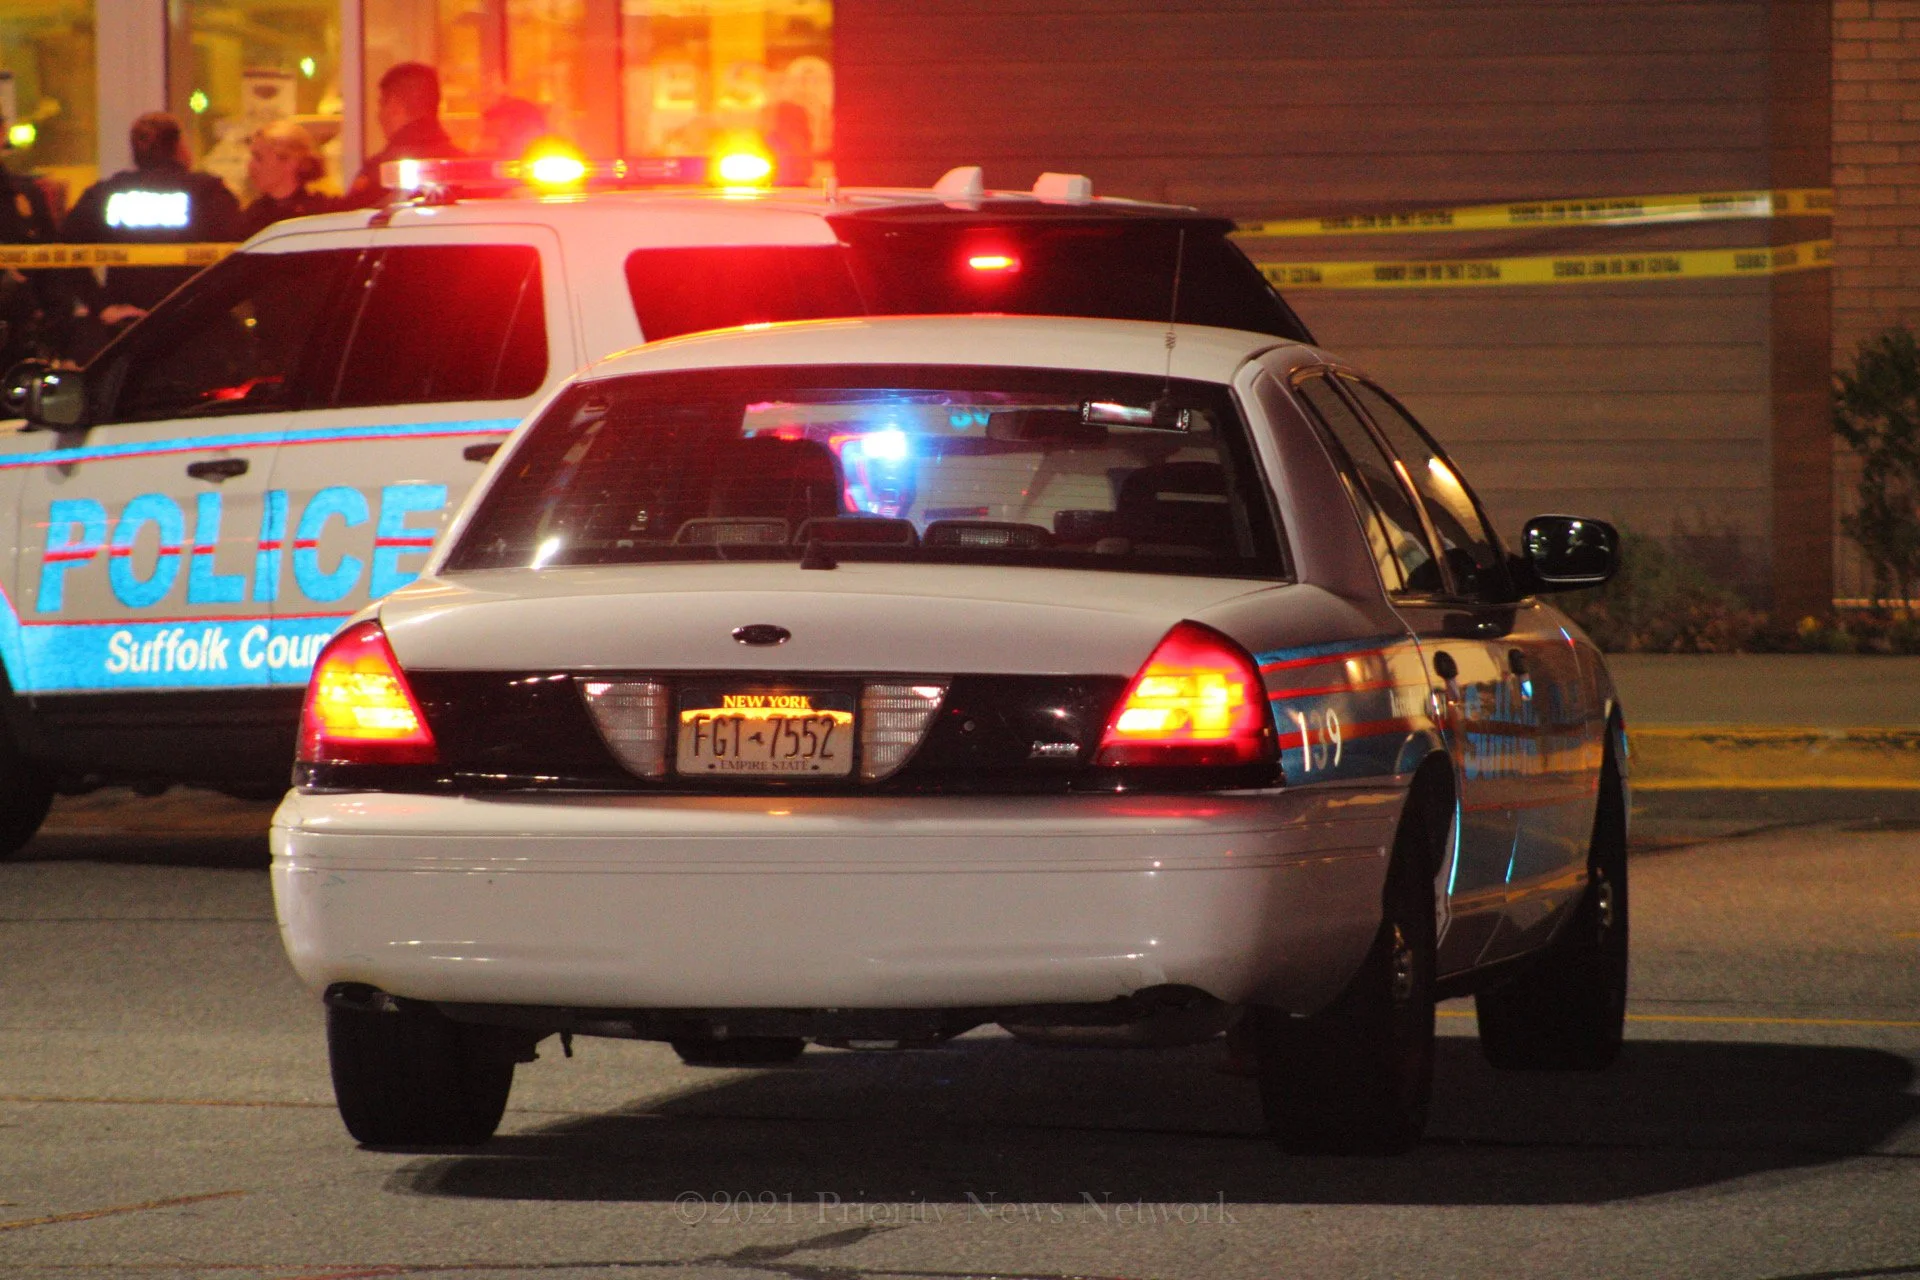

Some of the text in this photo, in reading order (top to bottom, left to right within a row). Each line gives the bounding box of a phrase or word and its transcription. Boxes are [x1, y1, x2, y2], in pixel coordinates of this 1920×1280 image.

[35, 484, 448, 613] POLICE
[105, 627, 230, 674] Suffolk
[723, 695, 812, 708] NEW YORK
[694, 714, 837, 759] FGT 7552
[720, 760, 809, 771] EMPIRE STATE
